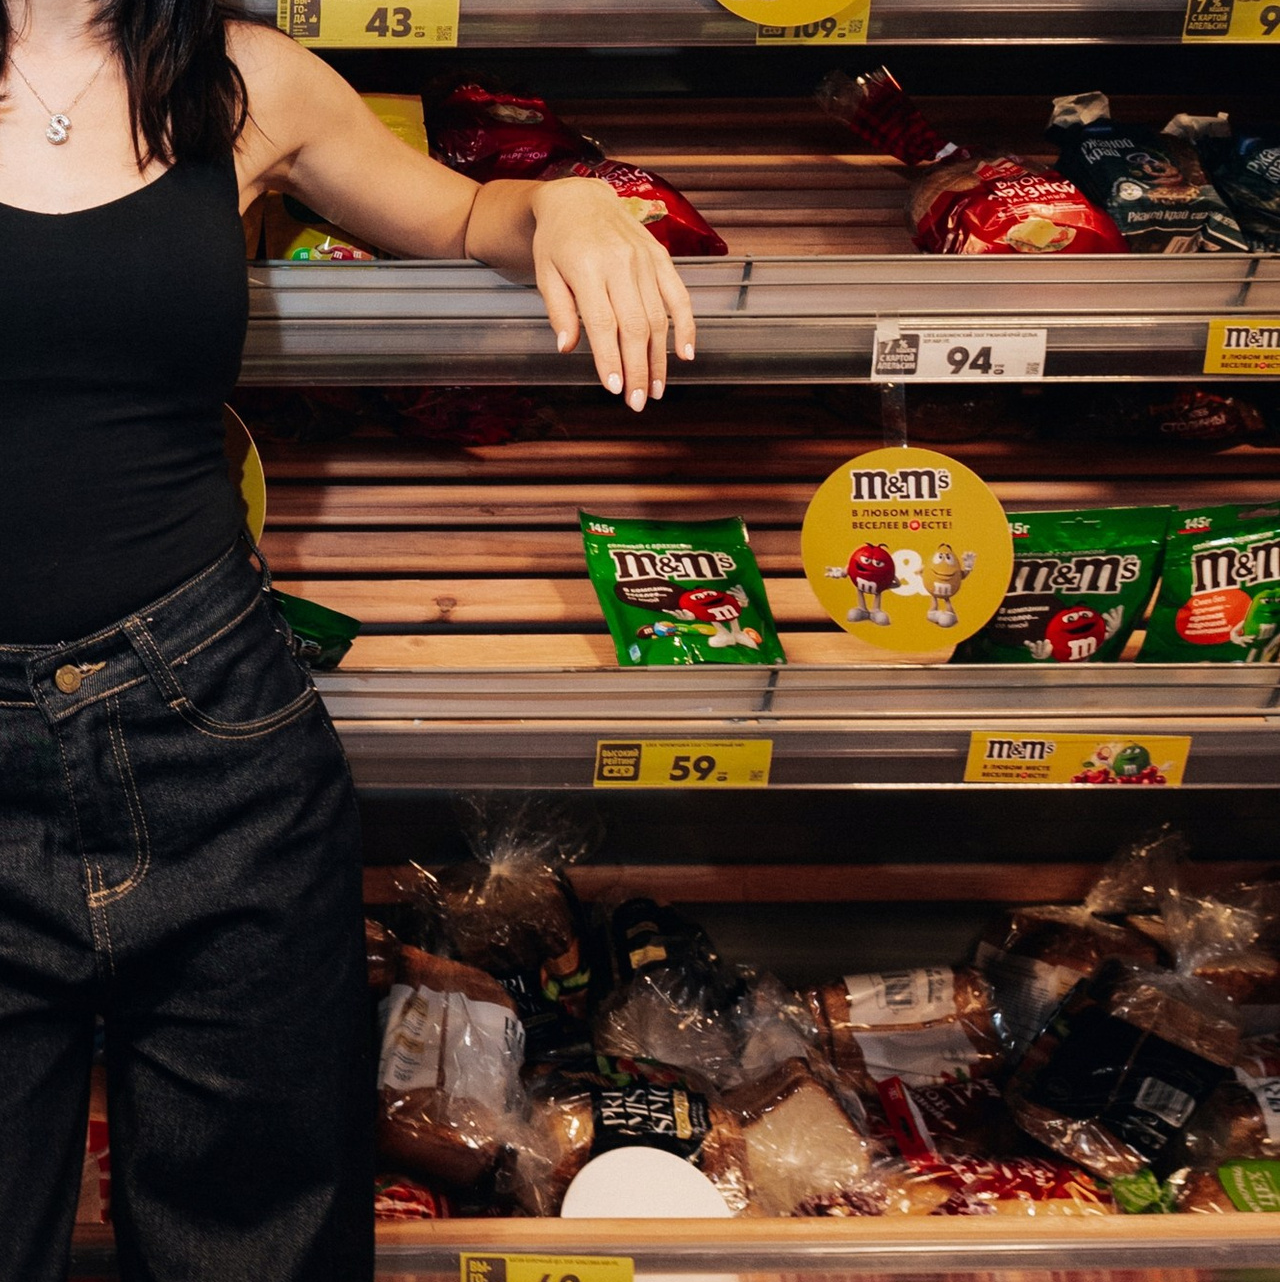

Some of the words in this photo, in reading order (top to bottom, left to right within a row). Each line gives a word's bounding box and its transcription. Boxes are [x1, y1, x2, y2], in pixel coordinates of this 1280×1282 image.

[293, 14, 306, 24] ДА
[365, 7, 412, 38] 43
[947, 346, 993, 374] 94
[850, 468, 952, 502] m&m's
[852, 509, 859, 517] В
[862, 509, 909, 517] ЛЮБОМ
[913, 508, 952, 517] МЕСТЕ
[852, 521, 900, 530] ВЕСЕЛЕЕ
[610, 550, 736, 581] m&m's
[986, 738, 1056, 760] m&m's
[669, 756, 716, 781] 59
